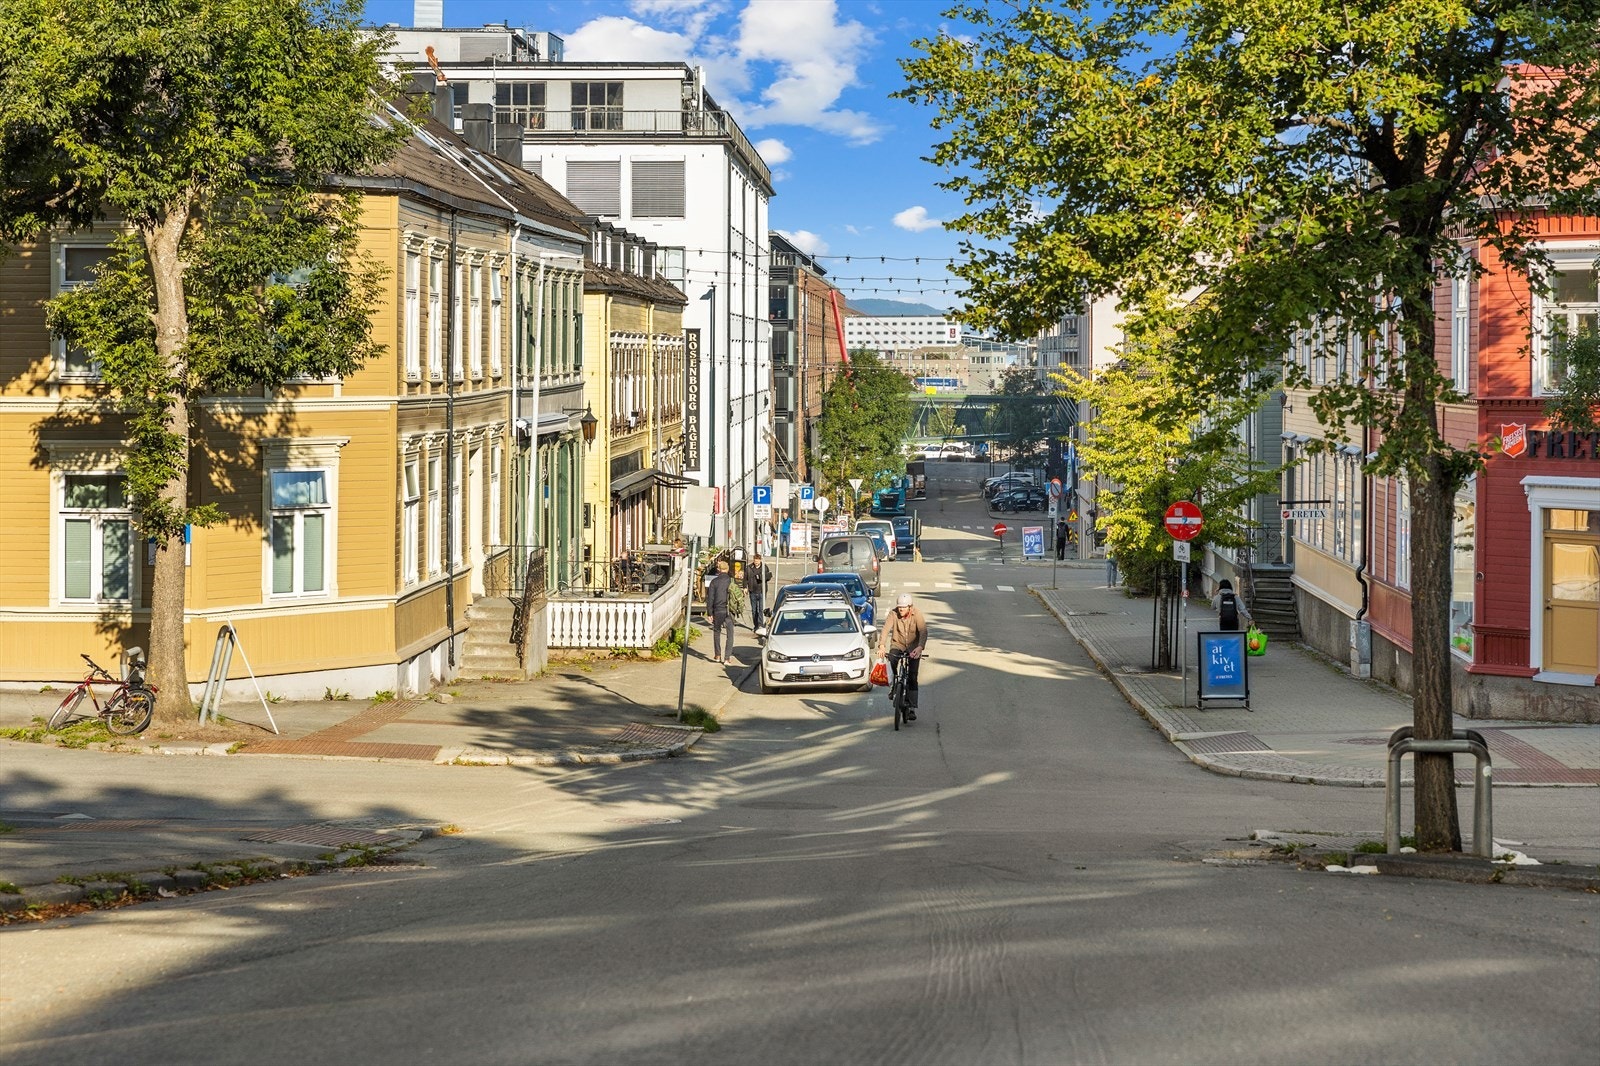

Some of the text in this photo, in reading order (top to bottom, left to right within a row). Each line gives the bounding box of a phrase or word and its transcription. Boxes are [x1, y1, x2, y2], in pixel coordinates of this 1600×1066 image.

[688, 333, 698, 467] ROSENBORG BAGERI
[757, 488, 767, 503] P
[803, 488, 811, 499] P
[1292, 510, 1326, 518] FRETEX
[1025, 535, 1035, 547] 99
[1212, 646, 1223, 654] ar
[1212, 654, 1229, 665] kiv
[1224, 661, 1235, 672] et
